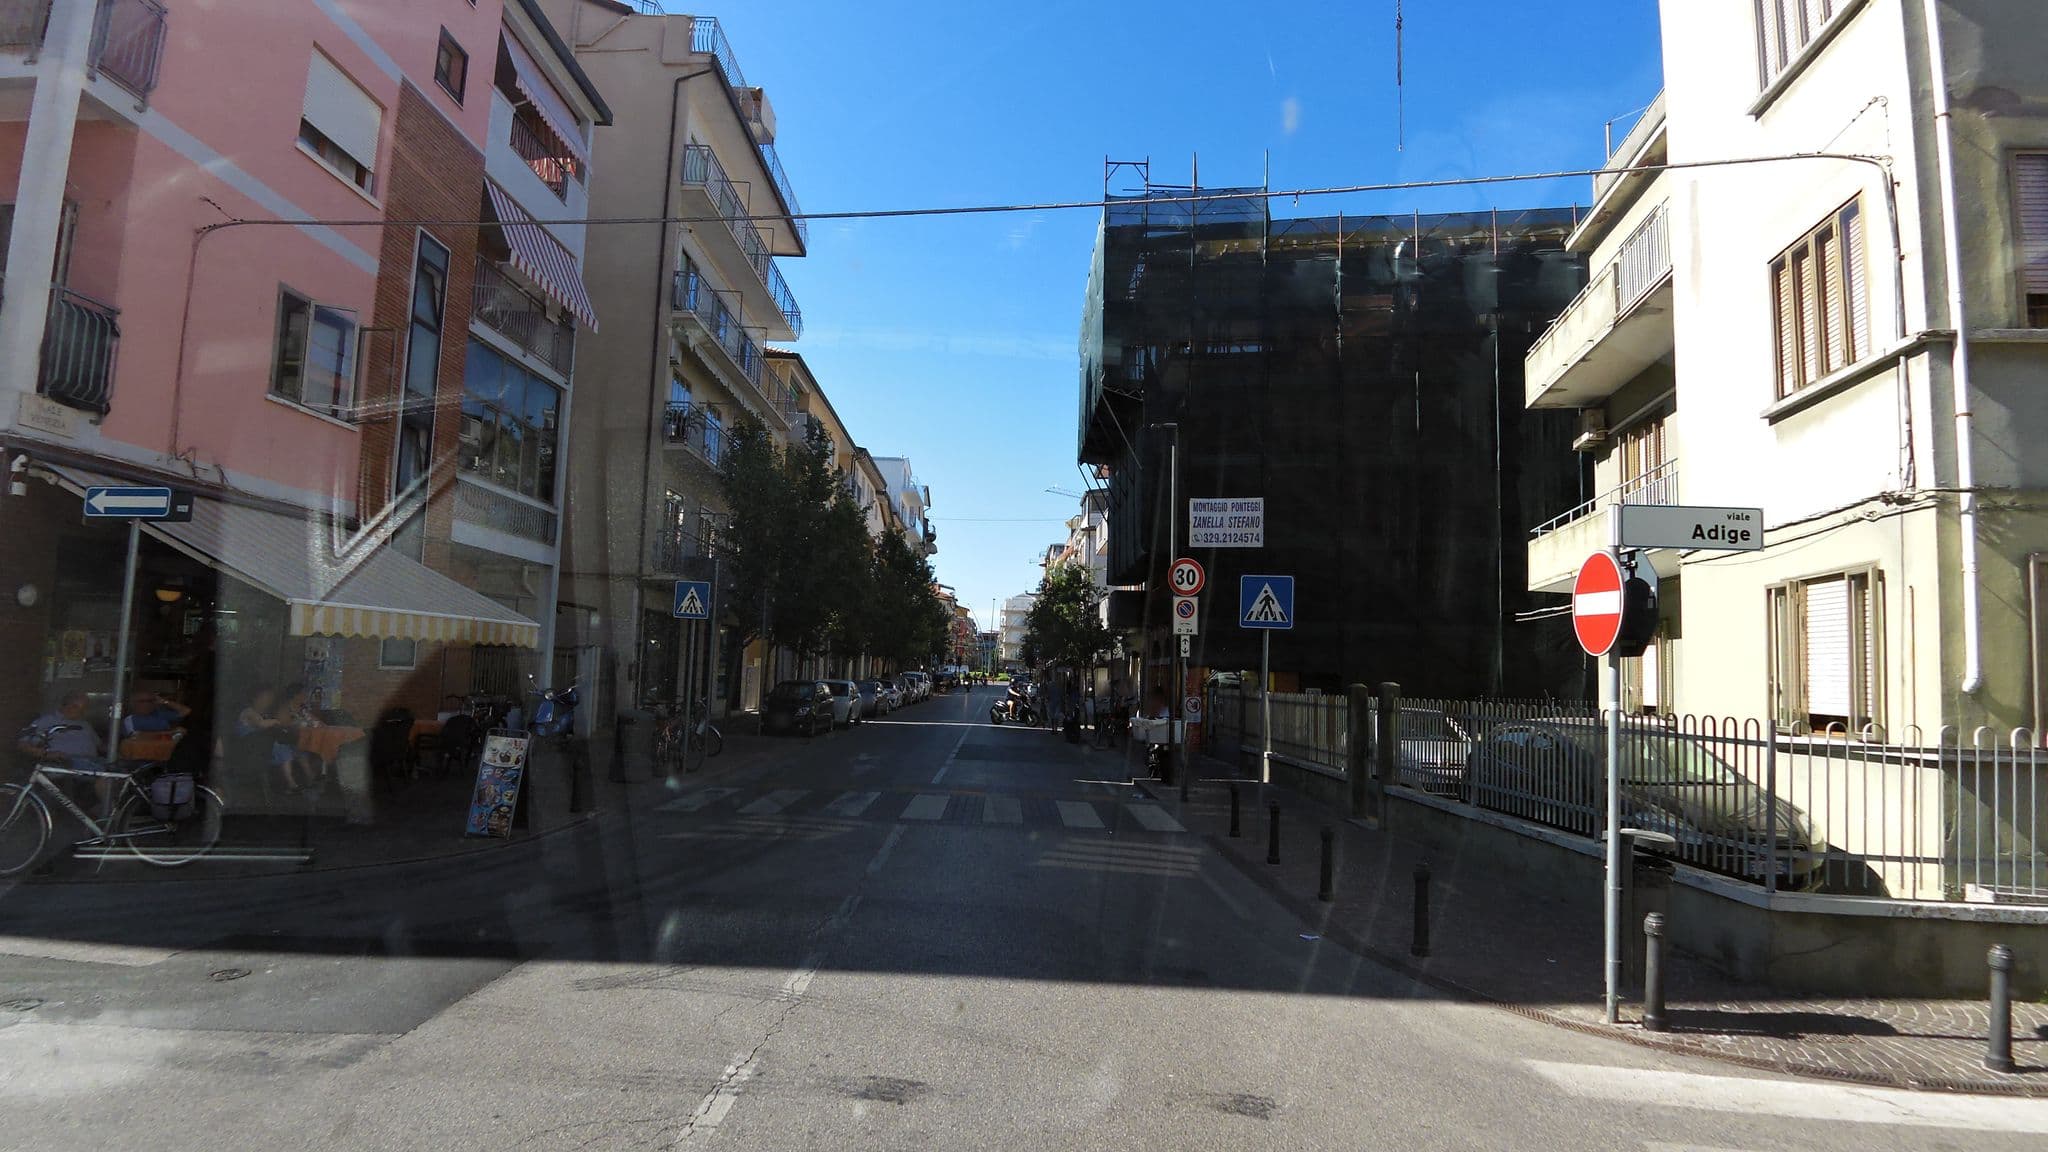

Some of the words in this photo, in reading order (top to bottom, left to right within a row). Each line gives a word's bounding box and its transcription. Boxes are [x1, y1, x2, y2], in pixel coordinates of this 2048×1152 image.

[1193, 502, 1228, 513] MONTAGGIO
[1231, 502, 1261, 512] PONTEGGI
[1193, 516, 1224, 528] ZANELLA
[1228, 516, 1260, 528] STEFANO
[1726, 512, 1751, 521] viale
[1203, 532, 1260, 543] 329.2124574
[1691, 523, 1751, 544] Adige
[1175, 568, 1196, 586] 30
